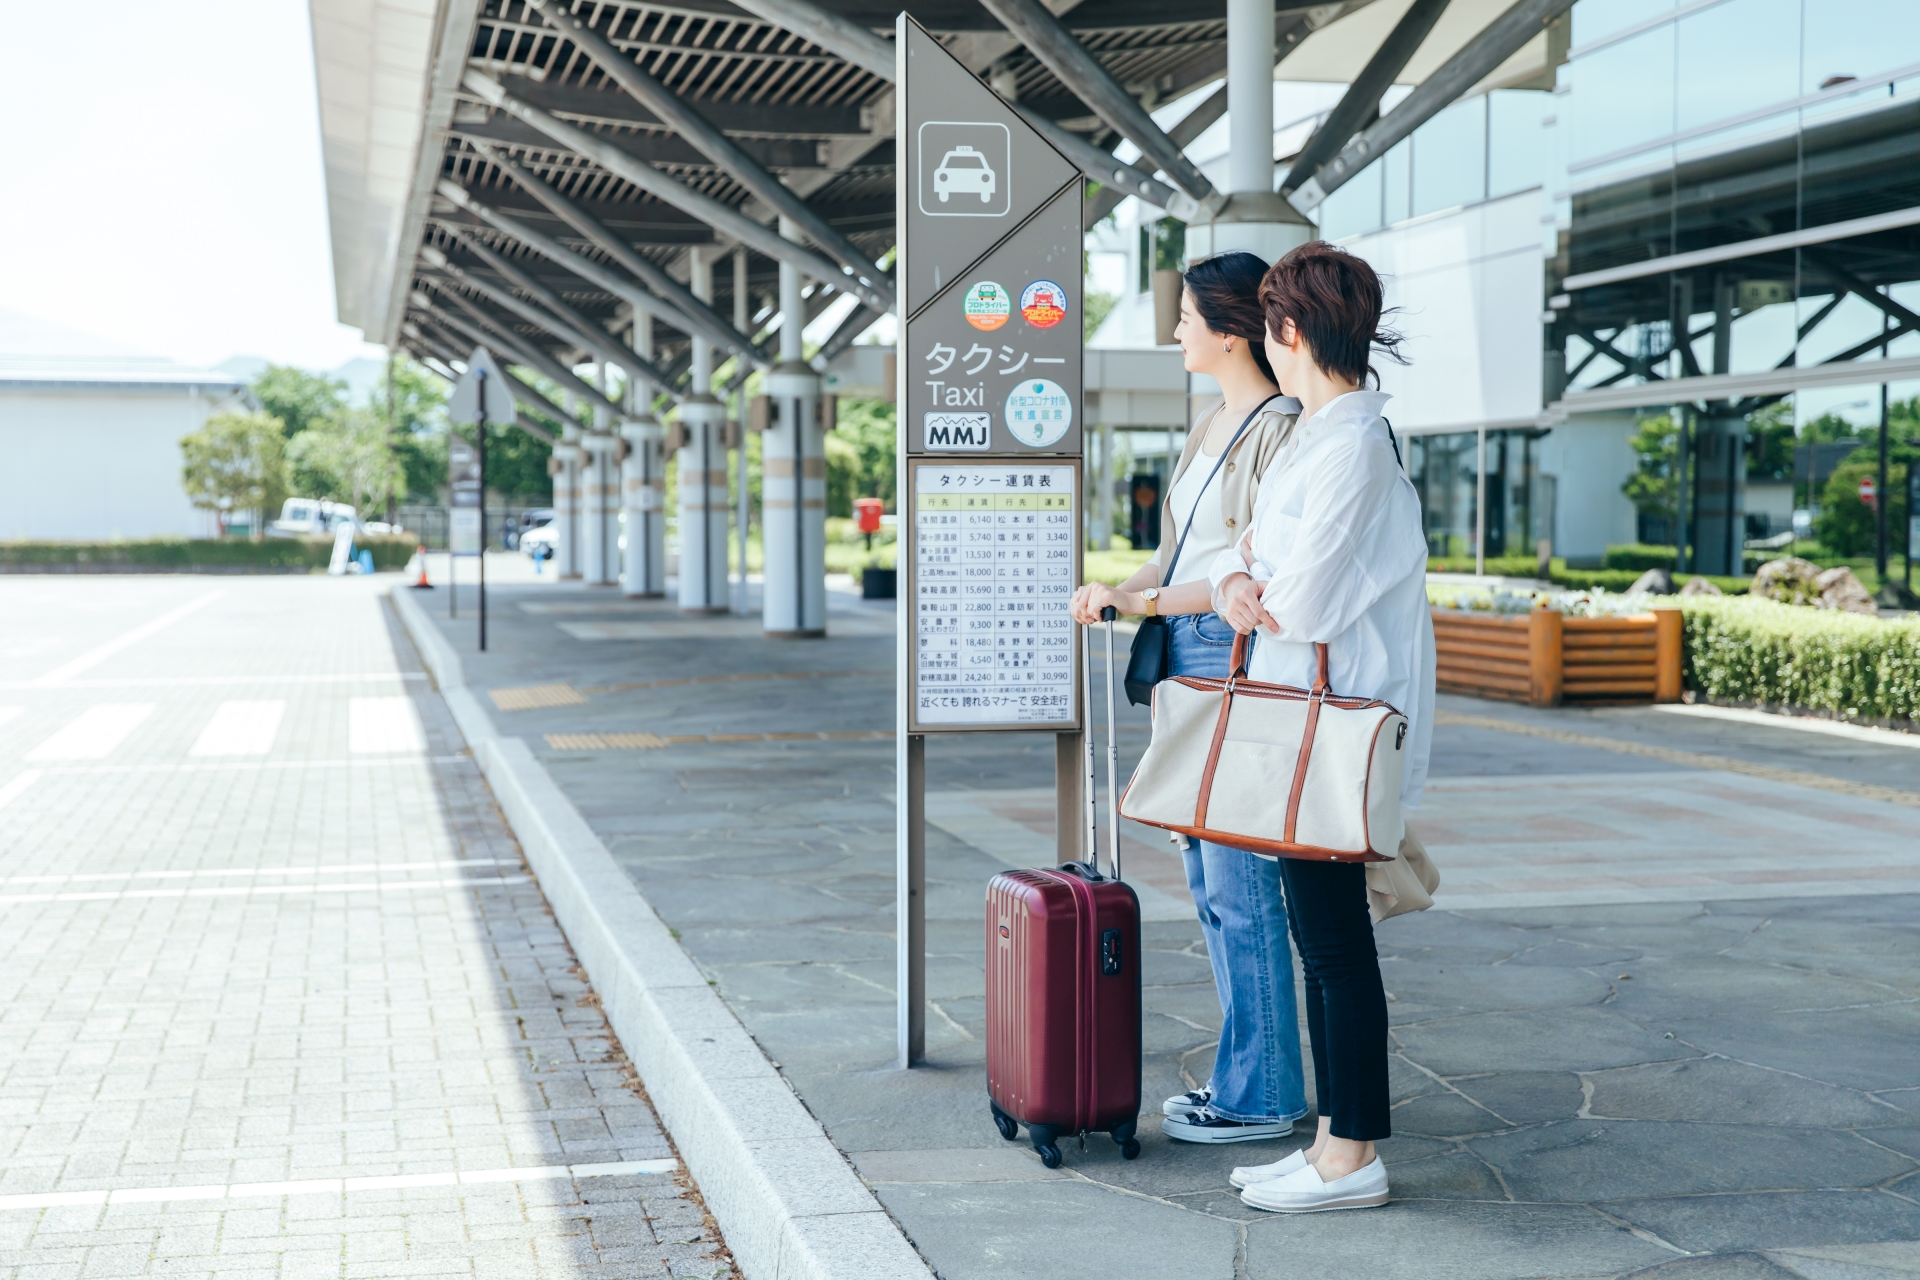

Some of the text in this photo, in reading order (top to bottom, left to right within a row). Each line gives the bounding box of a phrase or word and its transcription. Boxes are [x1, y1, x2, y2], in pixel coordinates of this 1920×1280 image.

[925, 342, 1065, 376] タクシー
[925, 381, 984, 406] Taxi
[1010, 395, 1066, 406] 新型コロナ対策
[1014, 410, 1062, 420] 推進宣言
[928, 427, 986, 446] MMJ
[940, 474, 1051, 487] タクシー運賃表
[928, 498, 1065, 506] 行先 運賃 行先 運賃
[920, 516, 957, 524] 浅間温泉
[969, 516, 991, 524] 6,140
[1046, 516, 1068, 524] 4,340
[970, 533, 991, 541] 5,740
[998, 533, 1034, 541] 塩尻駅
[1046, 533, 1068, 541] 3,340
[966, 551, 991, 559] 13,530
[998, 550, 1034, 558] 村井駅
[1046, 550, 1068, 559] 2,040
[965, 568, 991, 577] 18,000
[998, 568, 1034, 576] 広丘駅
[966, 586, 991, 594] 15,690
[1042, 585, 1068, 594] 25,950
[965, 604, 991, 612] 22,800
[1042, 603, 1068, 611] 11,730
[970, 621, 991, 629] 9,300
[1042, 620, 1068, 628] 13,530
[966, 638, 991, 647] 18,480
[998, 638, 1034, 646] 長野駅
[1042, 638, 1068, 646] 28,290
[970, 656, 991, 664] 4,540
[1046, 655, 1068, 663] 9,300
[965, 673, 991, 682] 24,240
[998, 672, 1034, 680] 高山駅
[1042, 672, 1068, 680] 30,990
[921, 695, 1068, 708] 近くても 誇れるマナーで 安全走行
